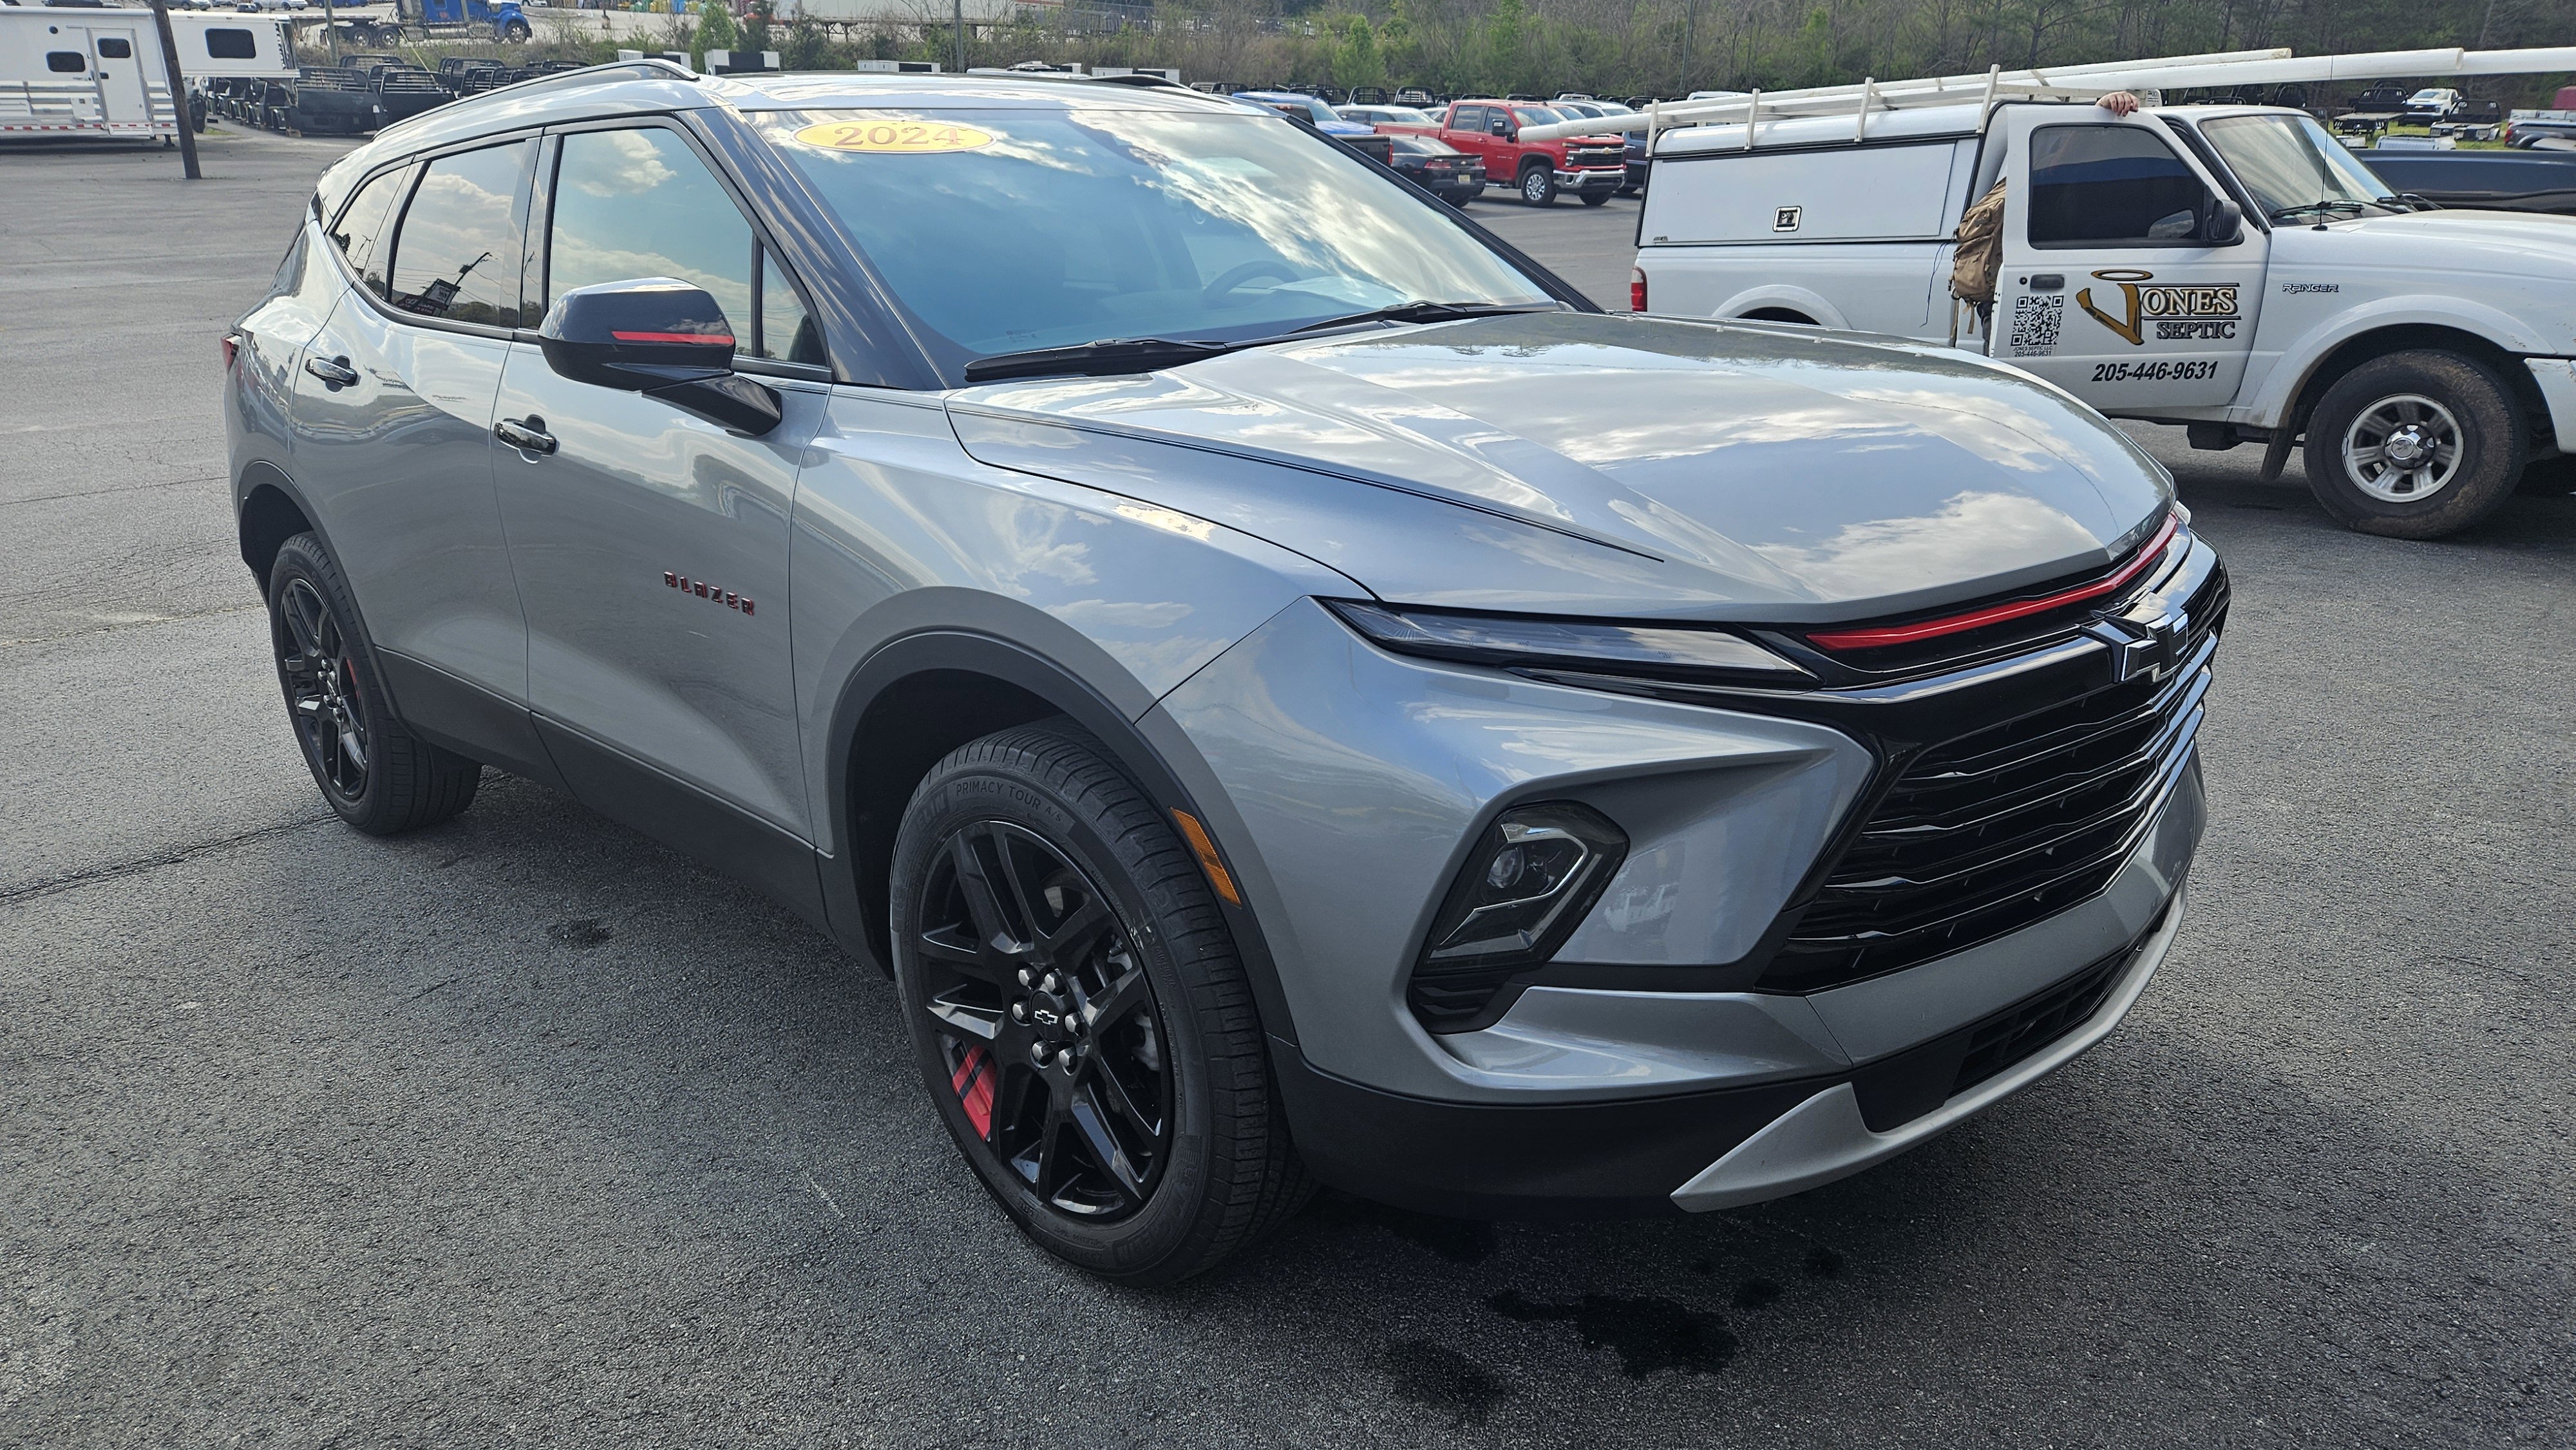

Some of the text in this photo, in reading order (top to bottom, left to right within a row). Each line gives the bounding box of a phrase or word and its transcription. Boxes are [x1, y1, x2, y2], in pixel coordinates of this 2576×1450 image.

[834, 127, 965, 146] 2024
[2076, 283, 2239, 346] JONES
[2156, 321, 2235, 339] SEPTIC
[2092, 361, 2219, 382] 205-446-9631
[663, 571, 755, 616] BLAZER
[957, 780, 1062, 822] PRIMACY TOUR A/S
